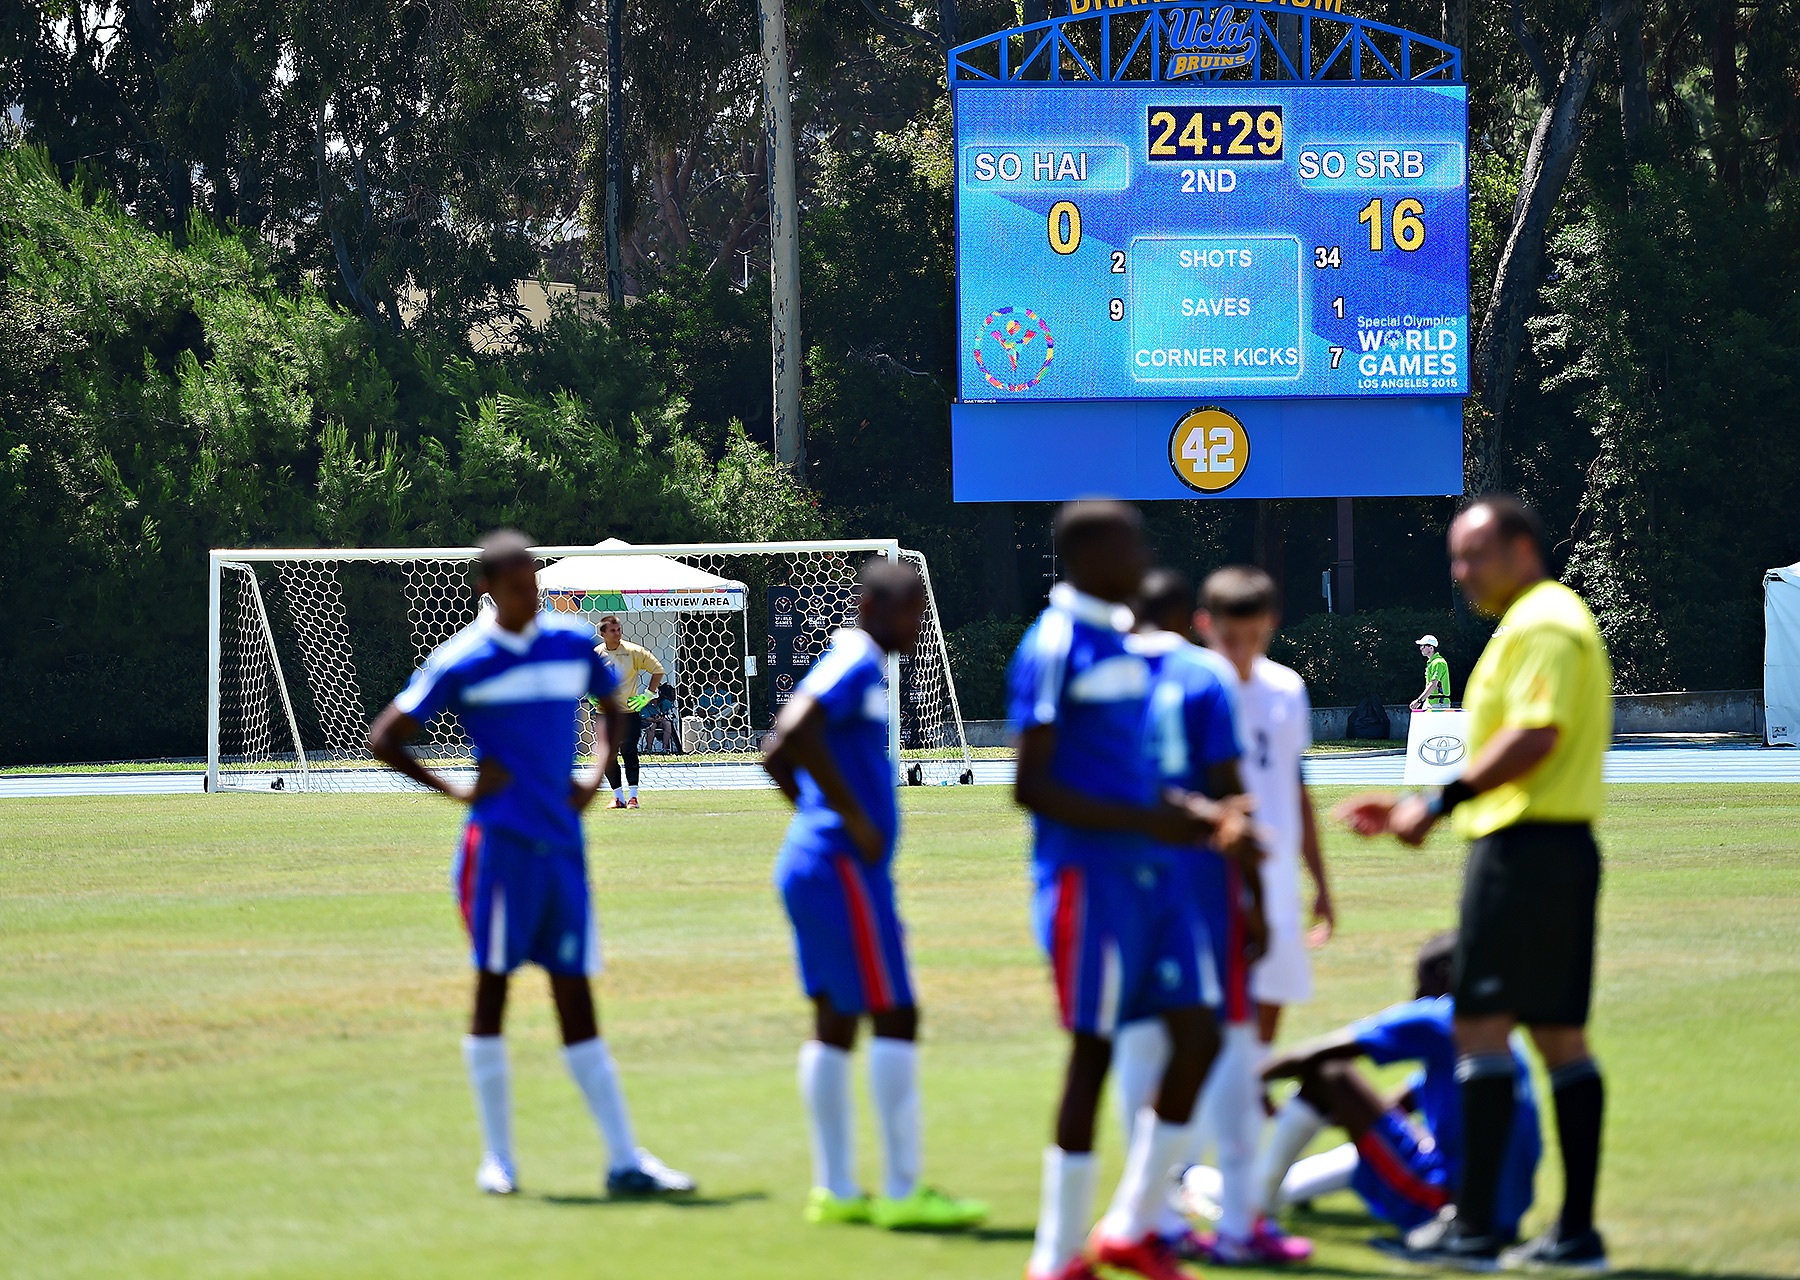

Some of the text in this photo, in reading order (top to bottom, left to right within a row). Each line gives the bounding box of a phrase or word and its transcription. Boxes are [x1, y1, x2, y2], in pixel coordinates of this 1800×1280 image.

[1173, 54, 1246, 76] BRUINS
[1150, 111, 1283, 155] 24:29
[974, 152, 1088, 181] SO HAI
[1299, 150, 1425, 179] SO SRB
[1181, 168, 1237, 193] 2ND
[1047, 200, 1082, 255] 0
[1358, 198, 1426, 252] 16
[1110, 251, 1126, 273] 2
[1178, 249, 1252, 268] SHOTS
[1314, 246, 1342, 269] 34
[1109, 298, 1125, 321] 9
[1181, 298, 1251, 317] SAVES
[1332, 296, 1345, 319] 1
[1357, 314, 1458, 329] Special Olympics
[1135, 347, 1299, 367] CORNER KICKS
[1329, 347, 1343, 369] 7
[1358, 353, 1457, 376] GAMES
[1358, 377, 1458, 389] LOS ANGELES 2015
[1181, 427, 1234, 473] 42
[642, 597, 730, 607] INTERVIEW AREA
